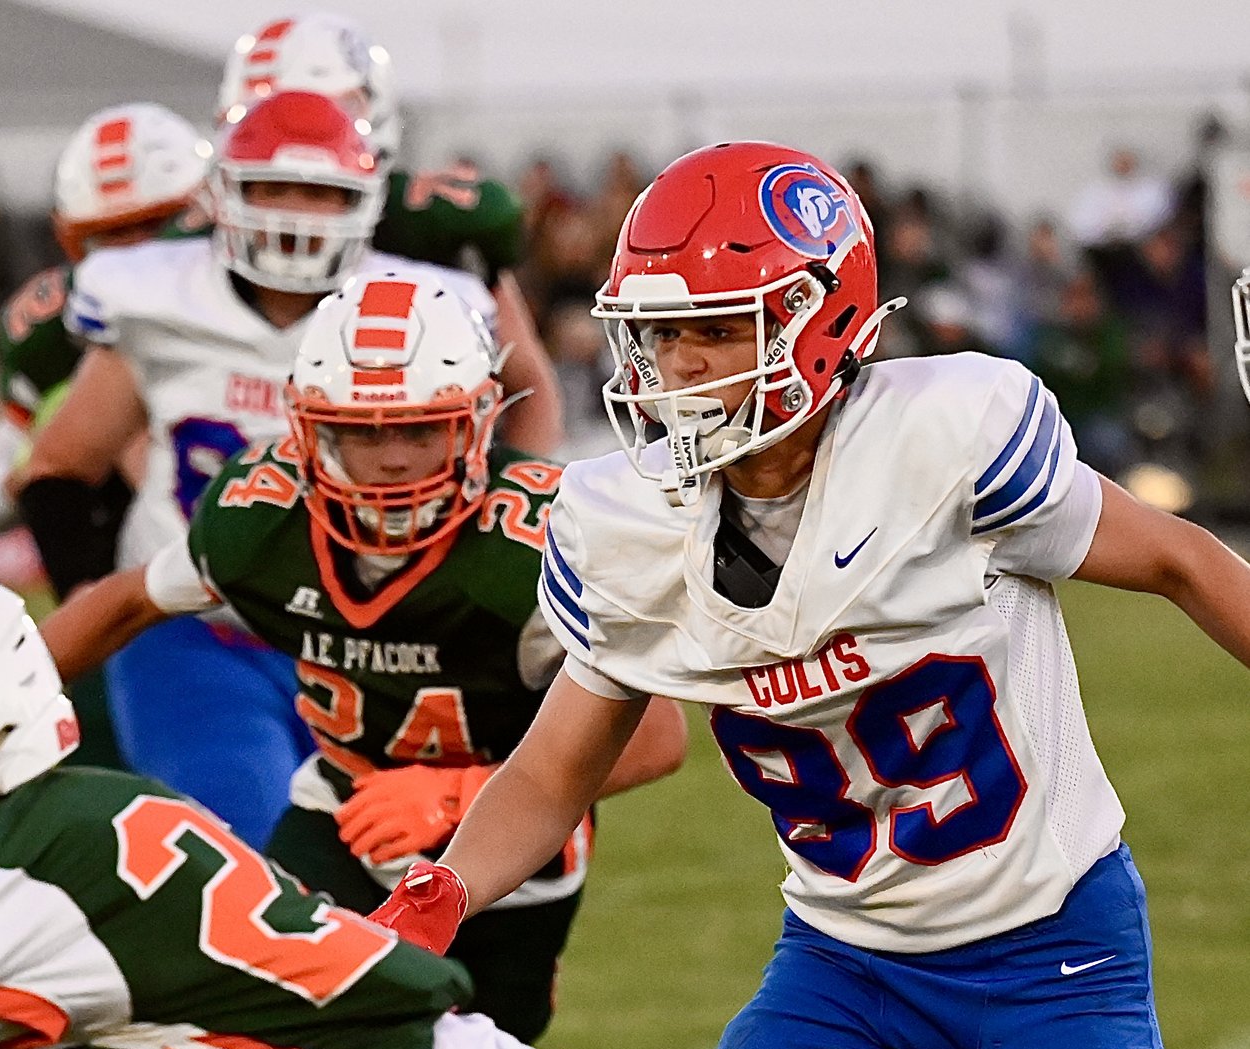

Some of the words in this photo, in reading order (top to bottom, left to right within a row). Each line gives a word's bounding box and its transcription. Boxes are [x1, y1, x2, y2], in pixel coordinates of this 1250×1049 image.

[628, 339, 659, 388] Riddell
[741, 632, 871, 708] COLTS
[295, 659, 475, 782] 24
[710, 652, 1028, 883] 89
